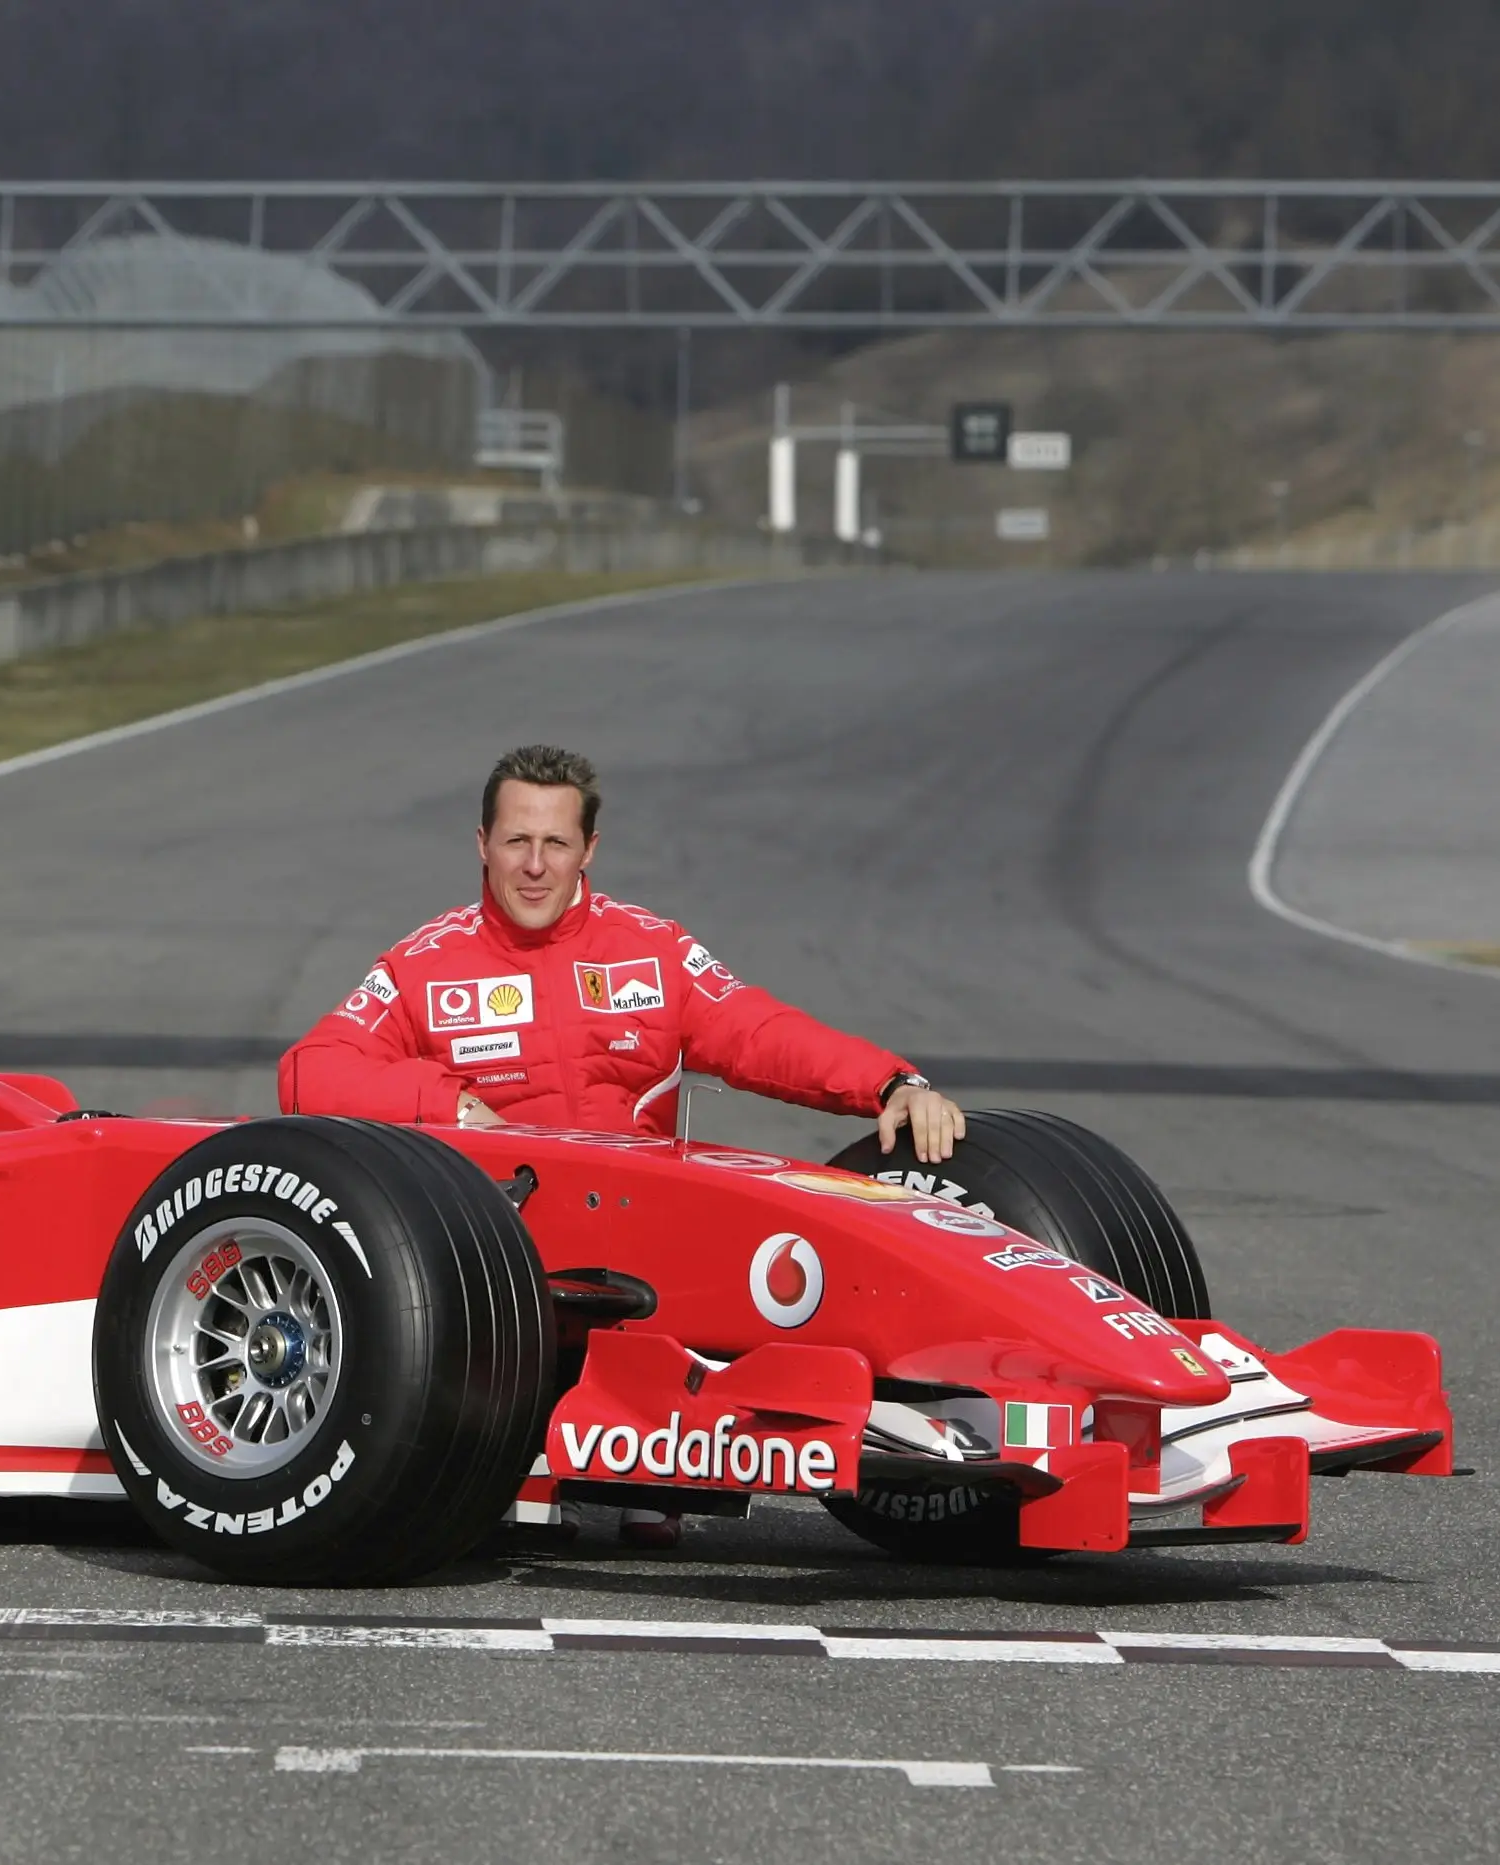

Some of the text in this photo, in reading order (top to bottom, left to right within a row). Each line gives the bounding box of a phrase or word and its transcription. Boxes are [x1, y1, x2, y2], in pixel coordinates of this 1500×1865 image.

[613, 992, 661, 1010] Marlboro
[459, 1041, 514, 1055] BRIDGESTONE
[476, 1072, 527, 1084] CHUMACHER
[133, 1163, 338, 1262] BRIDGESTONE
[187, 1238, 243, 1300] BBS
[174, 1401, 233, 1458] BBS
[562, 1411, 837, 1489] vodafone
[156, 1439, 356, 1535] POTENZA
